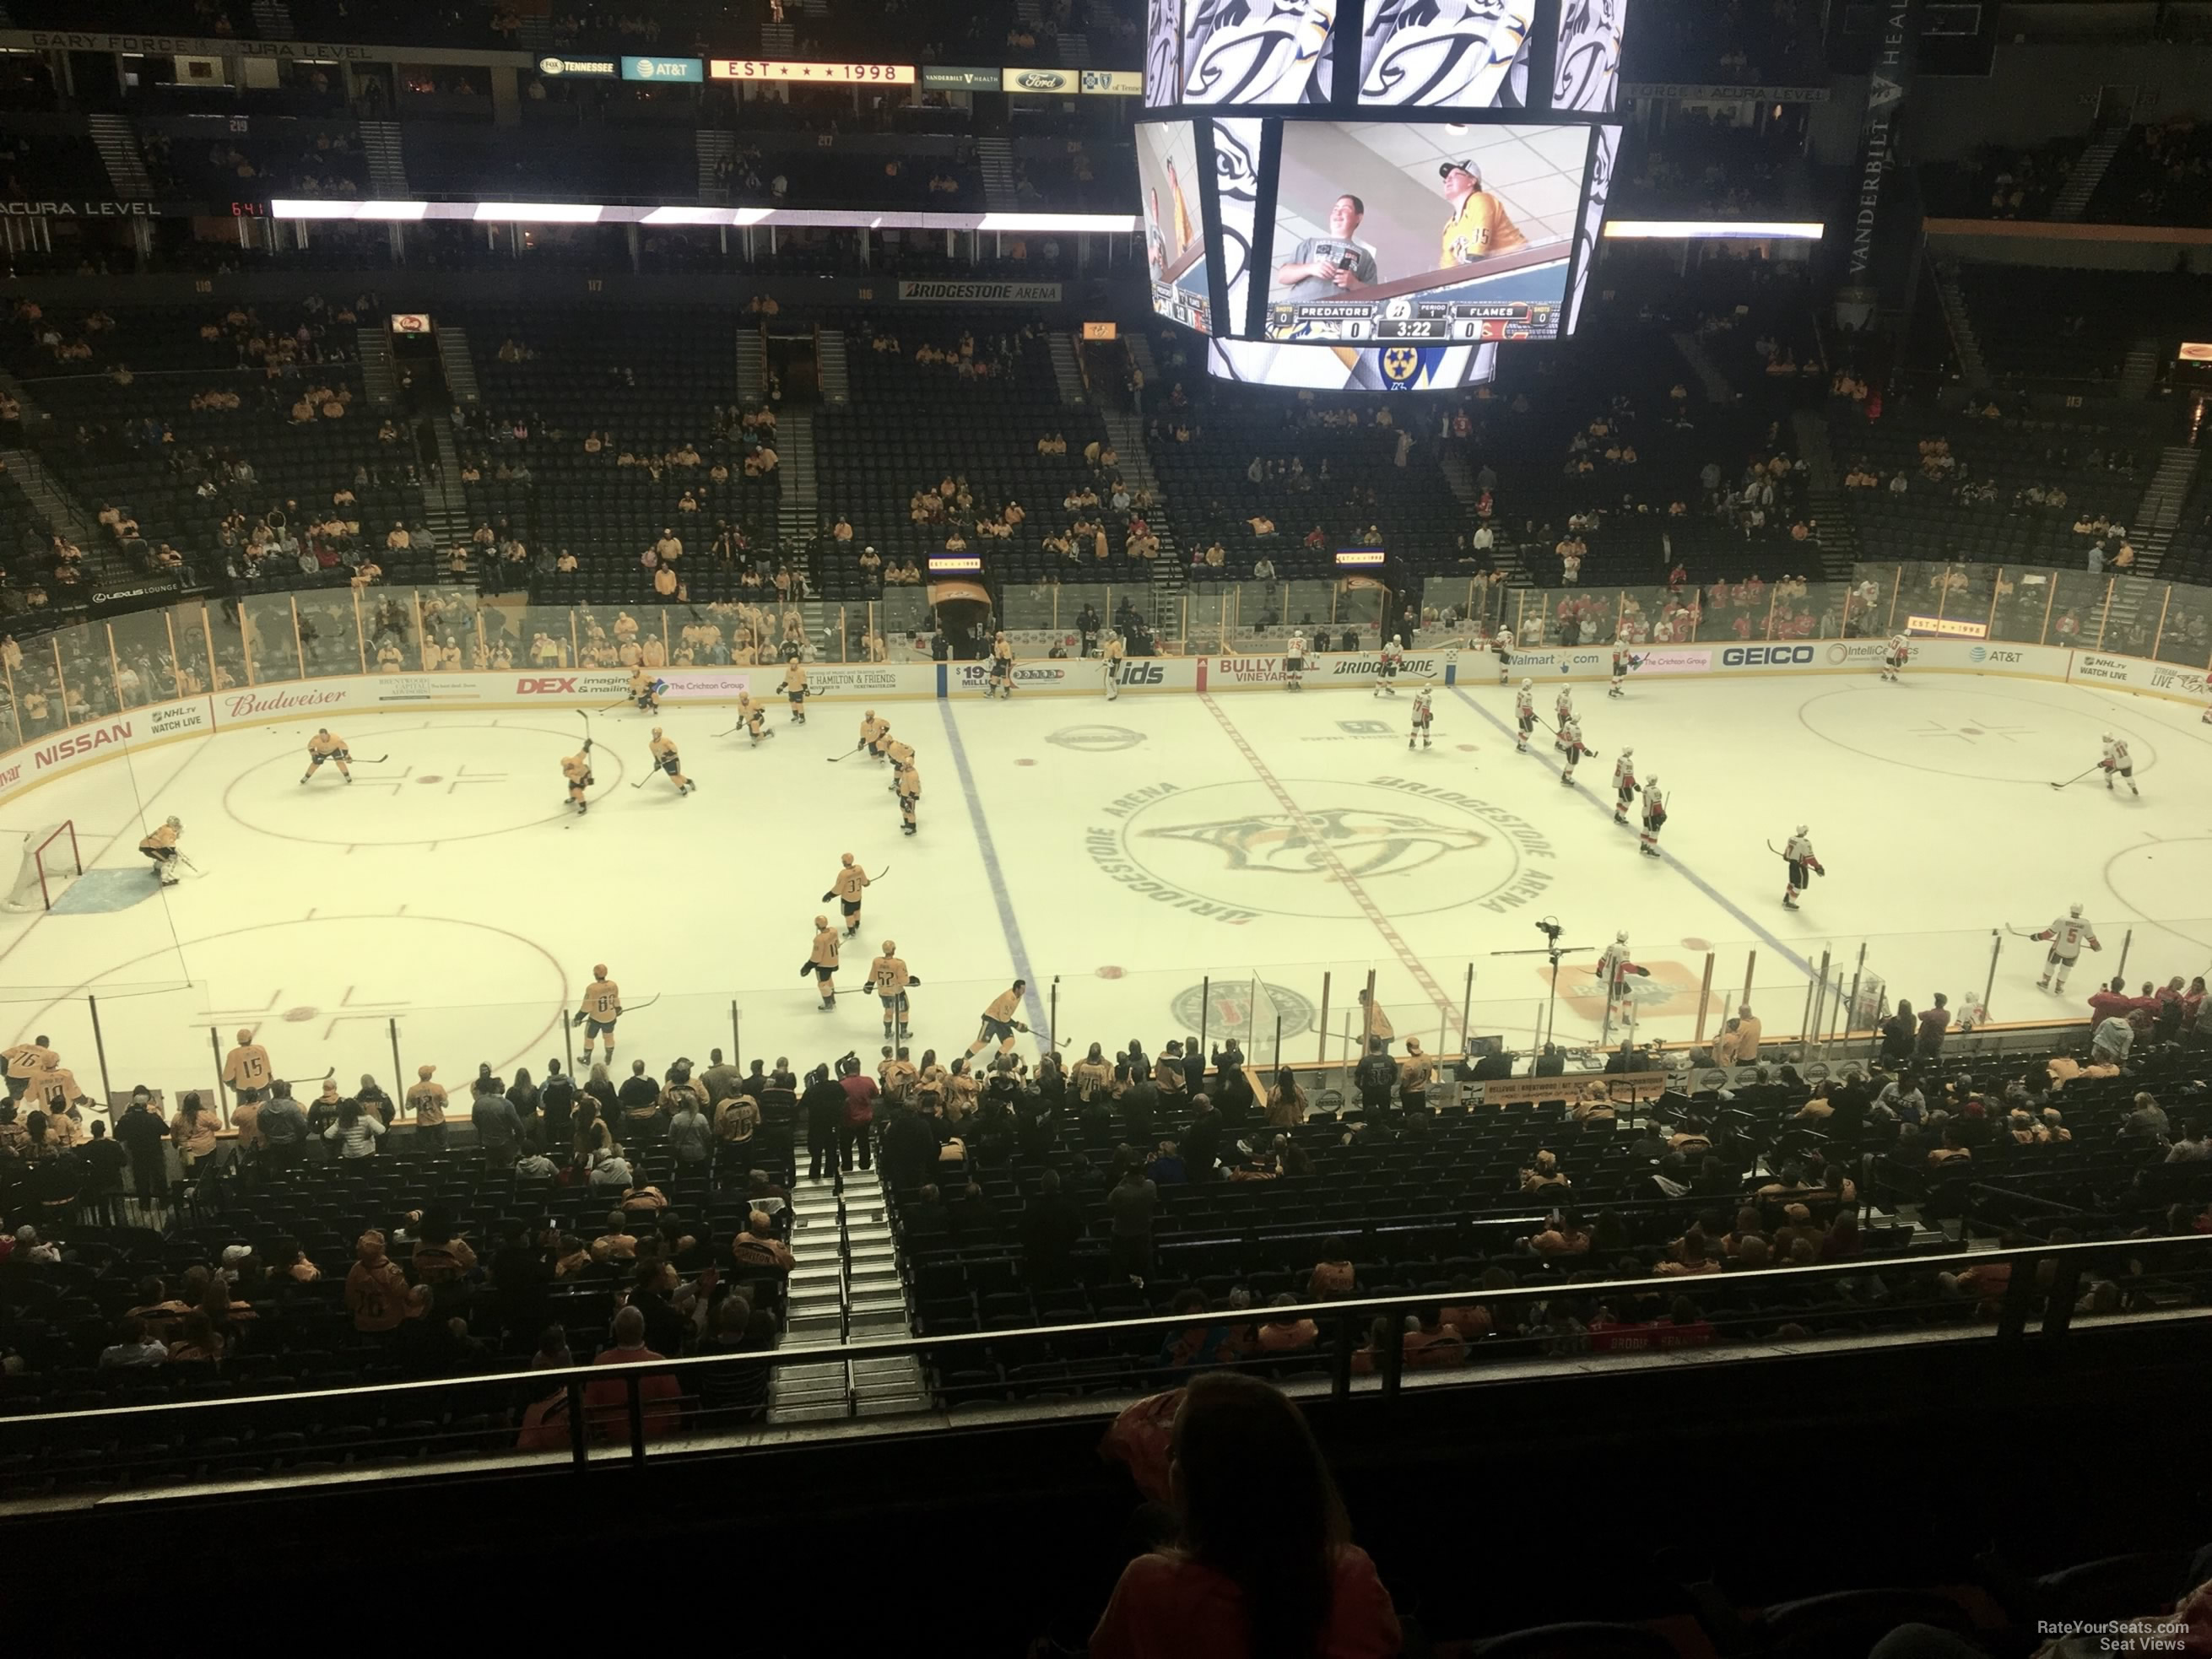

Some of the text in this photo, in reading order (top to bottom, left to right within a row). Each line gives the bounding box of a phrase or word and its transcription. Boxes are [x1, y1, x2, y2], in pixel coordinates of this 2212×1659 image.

[32, 34, 97, 49] GARY
[108, 36, 187, 51] FORCE
[303, 45, 373, 59] LEVEL
[564, 61, 614, 73] TENNESSEE
[656, 63, 688, 76] AT&T
[728, 62, 895, 80] EST 1998
[1025, 73, 1056, 88] Ford
[1712, 88, 1766, 100] ACURA
[1773, 89, 1824, 100] LEVEL
[1849, 119, 1890, 274] VANDERBILT
[84, 202, 161, 215] LEVEL
[905, 283, 1056, 299] BRIDGESTONE ARENA
[1280, 314, 1287, 322] 0
[1301, 307, 1369, 316] PREDATORS
[1469, 307, 1514, 316] FLAMES
[1539, 313, 1546, 322] 0
[1350, 322, 1360, 338] 0
[1397, 322, 1431, 337] 3:22
[1465, 322, 1474, 338] 0
[105, 583, 178, 600] LEXUS LOUNGE
[1912, 619, 1931, 628] EST
[1723, 646, 1814, 667] GEICO
[1848, 646, 1919, 656] IntelliCecs
[1988, 651, 2024, 663] AT&T
[1220, 658, 1276, 673] BULLY
[1333, 660, 1435, 674] BRIDGONE
[1573, 655, 1599, 664] com
[1687, 657, 1707, 666] Group
[816, 675, 854, 685] HAMILTON
[856, 674, 863, 684] &
[864, 673, 896, 684] FRIENDS
[1115, 661, 1164, 685] ids
[1236, 672, 1286, 682] VINEYAR
[2080, 667, 2128, 681] WATCH LIVE
[516, 677, 579, 694] DEX
[720, 681, 744, 690] Group
[2150, 674, 2175, 689] LIVE
[224, 689, 347, 717] Budweiser
[150, 716, 202, 734] WATCH LIVE
[34, 721, 133, 770] NISSAN
[1101, 782, 1182, 818] ARENA
[1366, 775, 1557, 913] BRIDGESTONE ARENA
[1085, 826, 1263, 925] BRIDGESTONE
[2066, 927, 2079, 944] 5
[877, 970, 895, 988] 52
[598, 993, 615, 1013] 89
[13, 1051, 41, 1067] 76
[242, 1057, 262, 1079] 15
[1611, 1337, 1648, 1349] BRODIE
